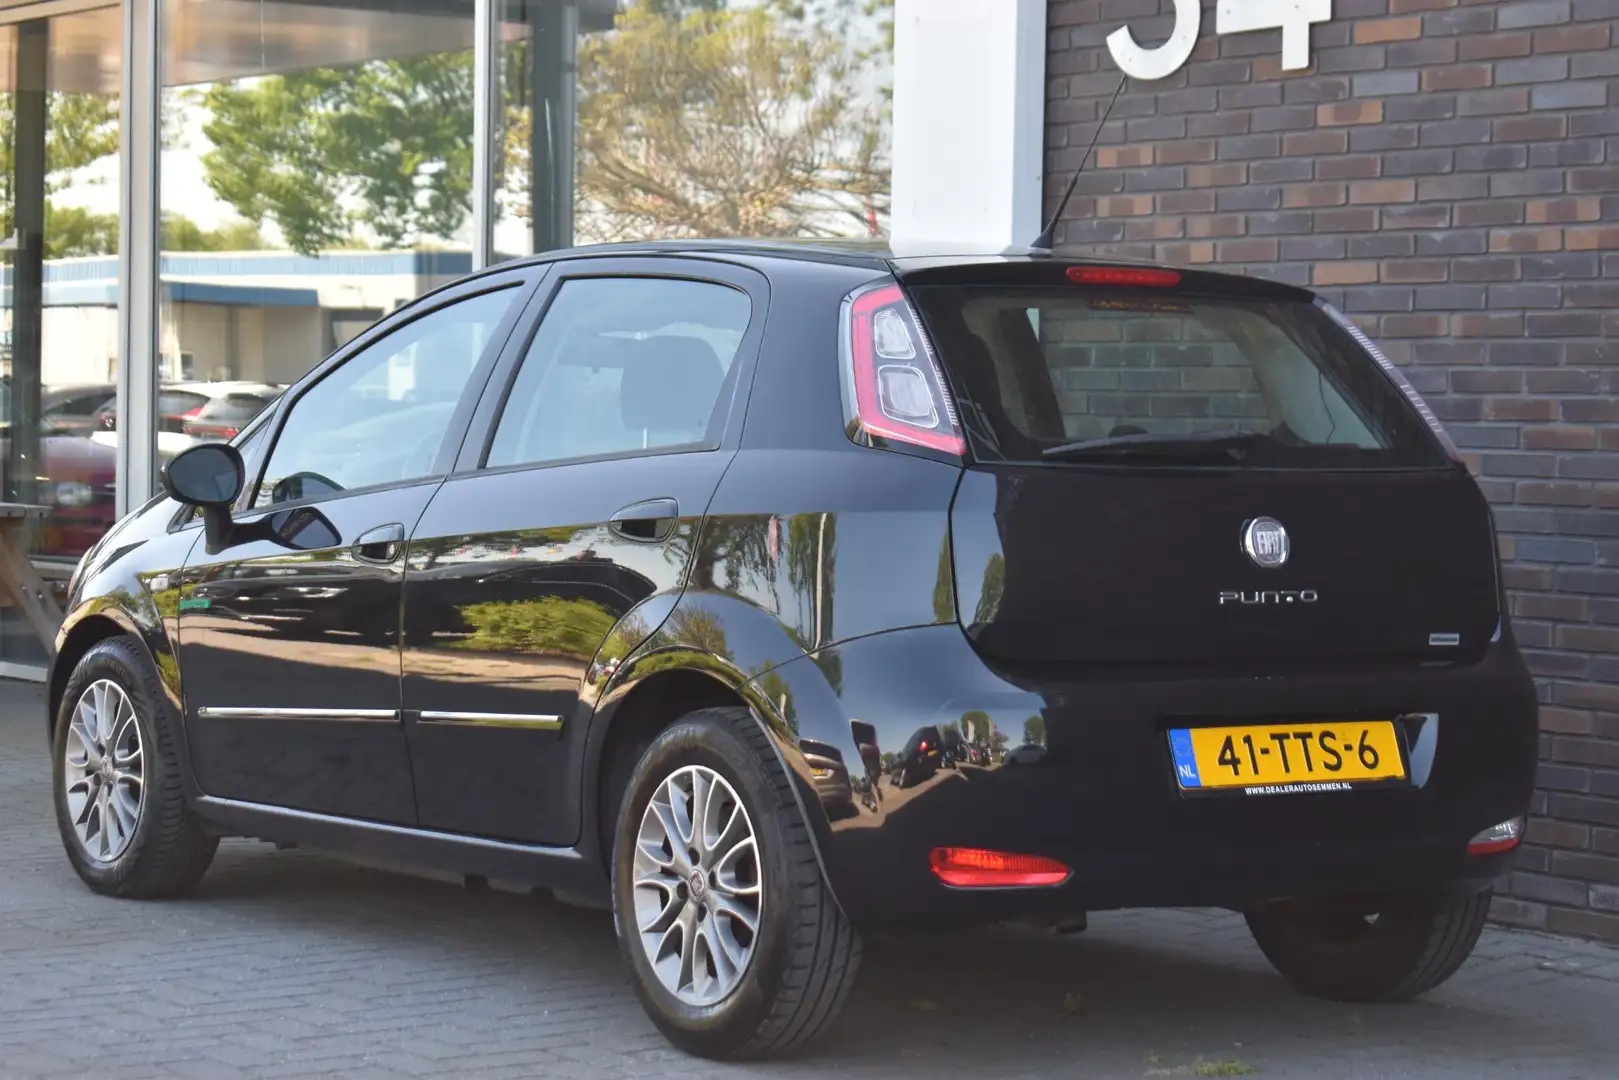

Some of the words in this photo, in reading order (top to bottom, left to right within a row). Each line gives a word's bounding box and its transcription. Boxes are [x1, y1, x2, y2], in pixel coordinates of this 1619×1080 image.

[1255, 530, 1280, 555] FIAT
[1217, 729, 1379, 776] 41-TTS-6
[1179, 764, 1197, 778] NL
[1245, 782, 1353, 796] WWW.DEALERAUTOSEMMEN.NL
